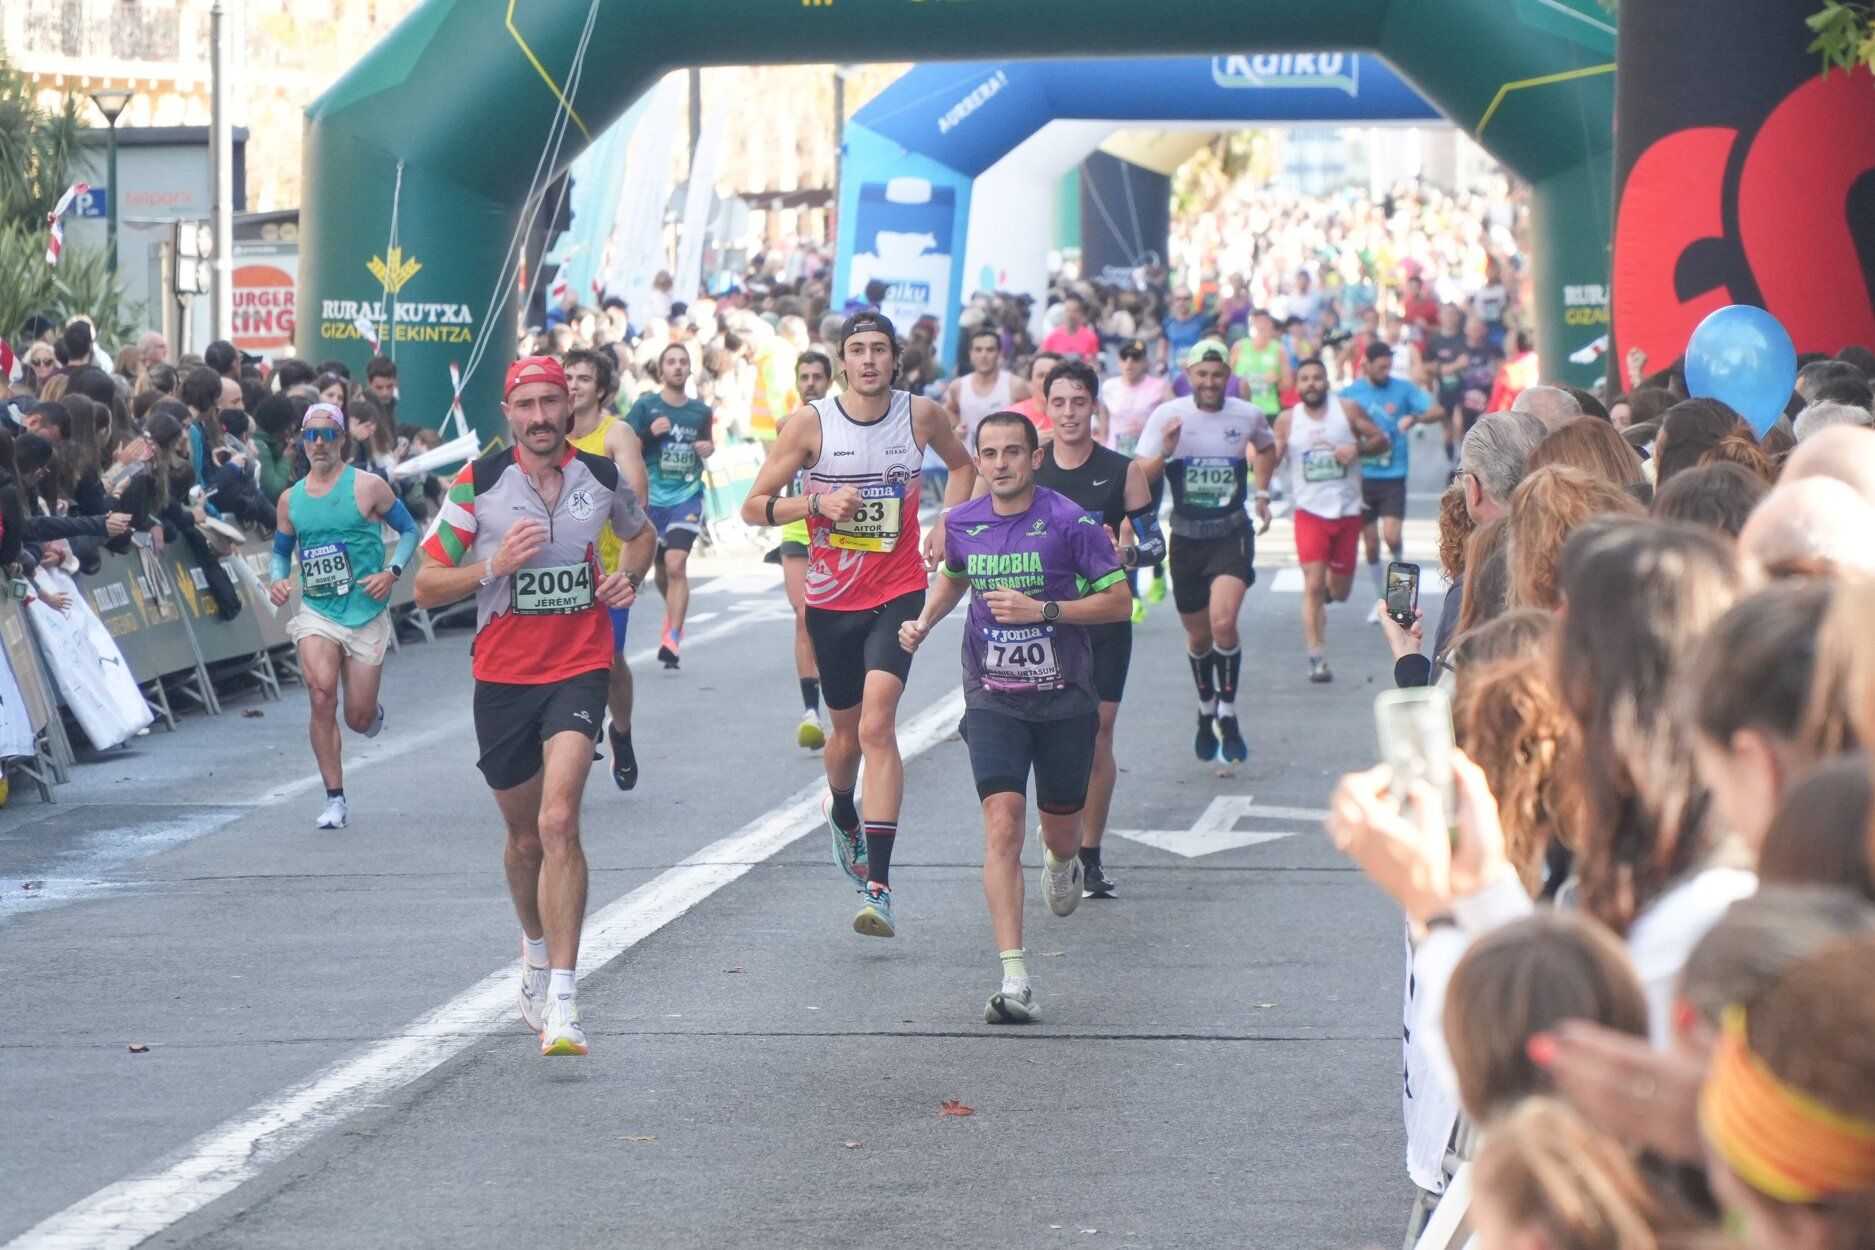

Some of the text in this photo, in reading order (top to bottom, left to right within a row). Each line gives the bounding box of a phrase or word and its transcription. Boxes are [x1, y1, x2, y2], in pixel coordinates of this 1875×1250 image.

[232, 291, 294, 307] URGER
[884, 281, 927, 302] aiku
[322, 300, 473, 324] RURAL KUTXA
[396, 325, 472, 342] EKINTZA
[663, 452, 695, 464] 2381
[1188, 469, 1232, 484] 2102
[860, 486, 895, 498] oma
[304, 555, 346, 577] 2188
[967, 551, 1043, 576] BEHOBIA
[518, 566, 590, 596] 2004
[993, 642, 1045, 667] 740
[1017, 666, 1055, 677] URTASUN
